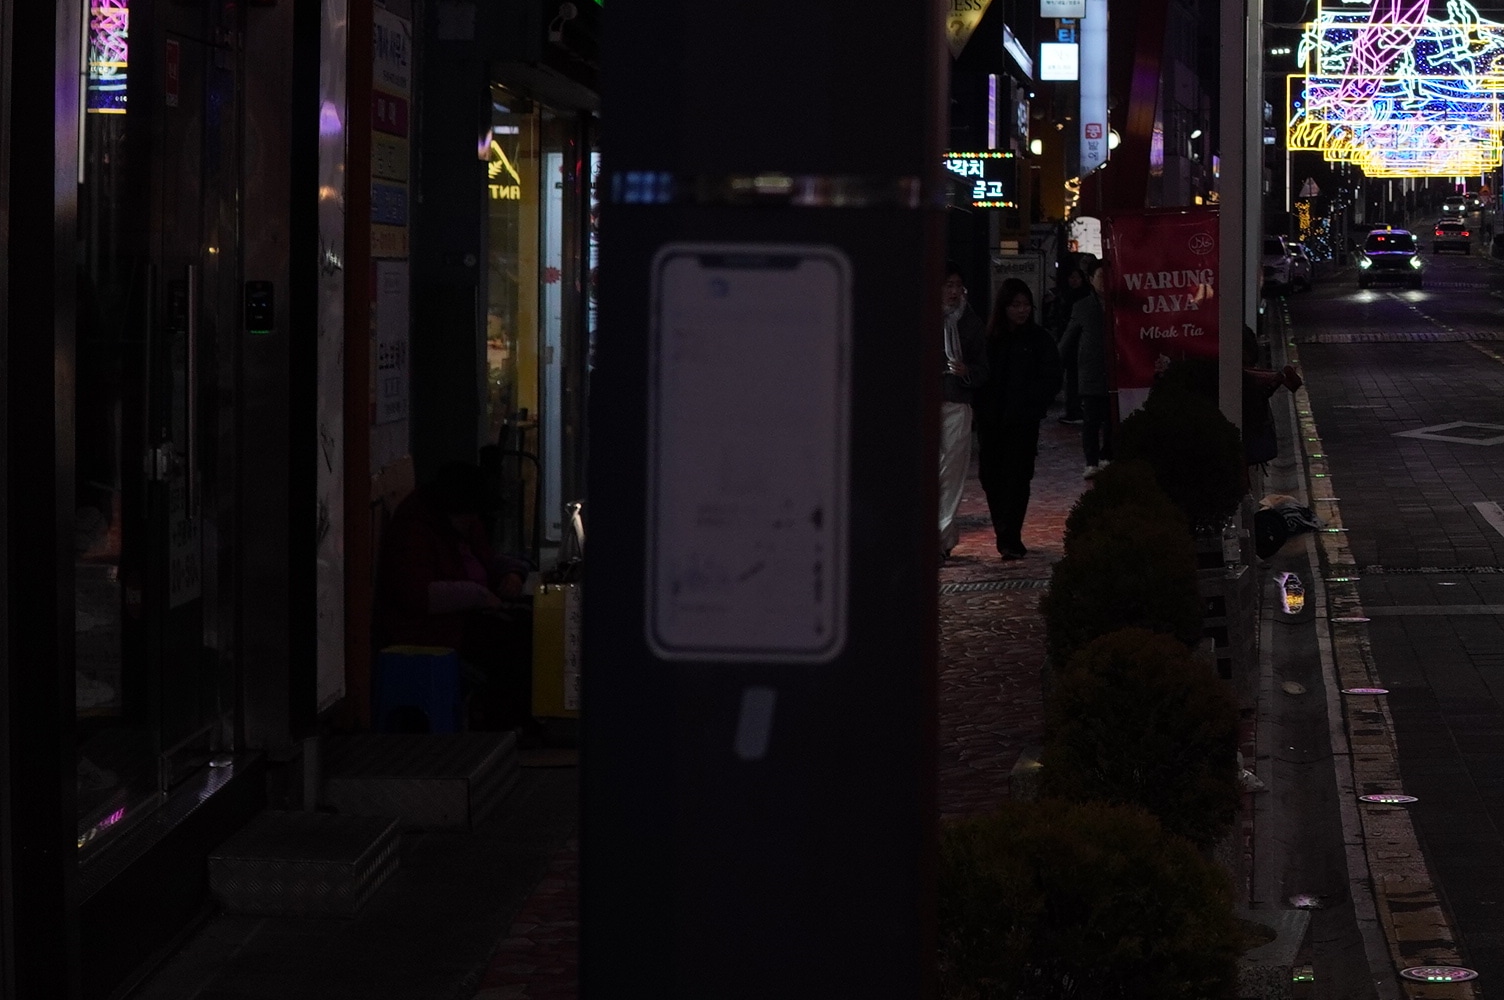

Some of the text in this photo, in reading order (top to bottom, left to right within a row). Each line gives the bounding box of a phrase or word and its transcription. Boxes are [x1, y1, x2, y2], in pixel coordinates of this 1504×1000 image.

[1123, 268, 1215, 291] WARUNG
[1142, 293, 1200, 314] JAYA
[1140, 323, 1204, 340] Mbak Tia
